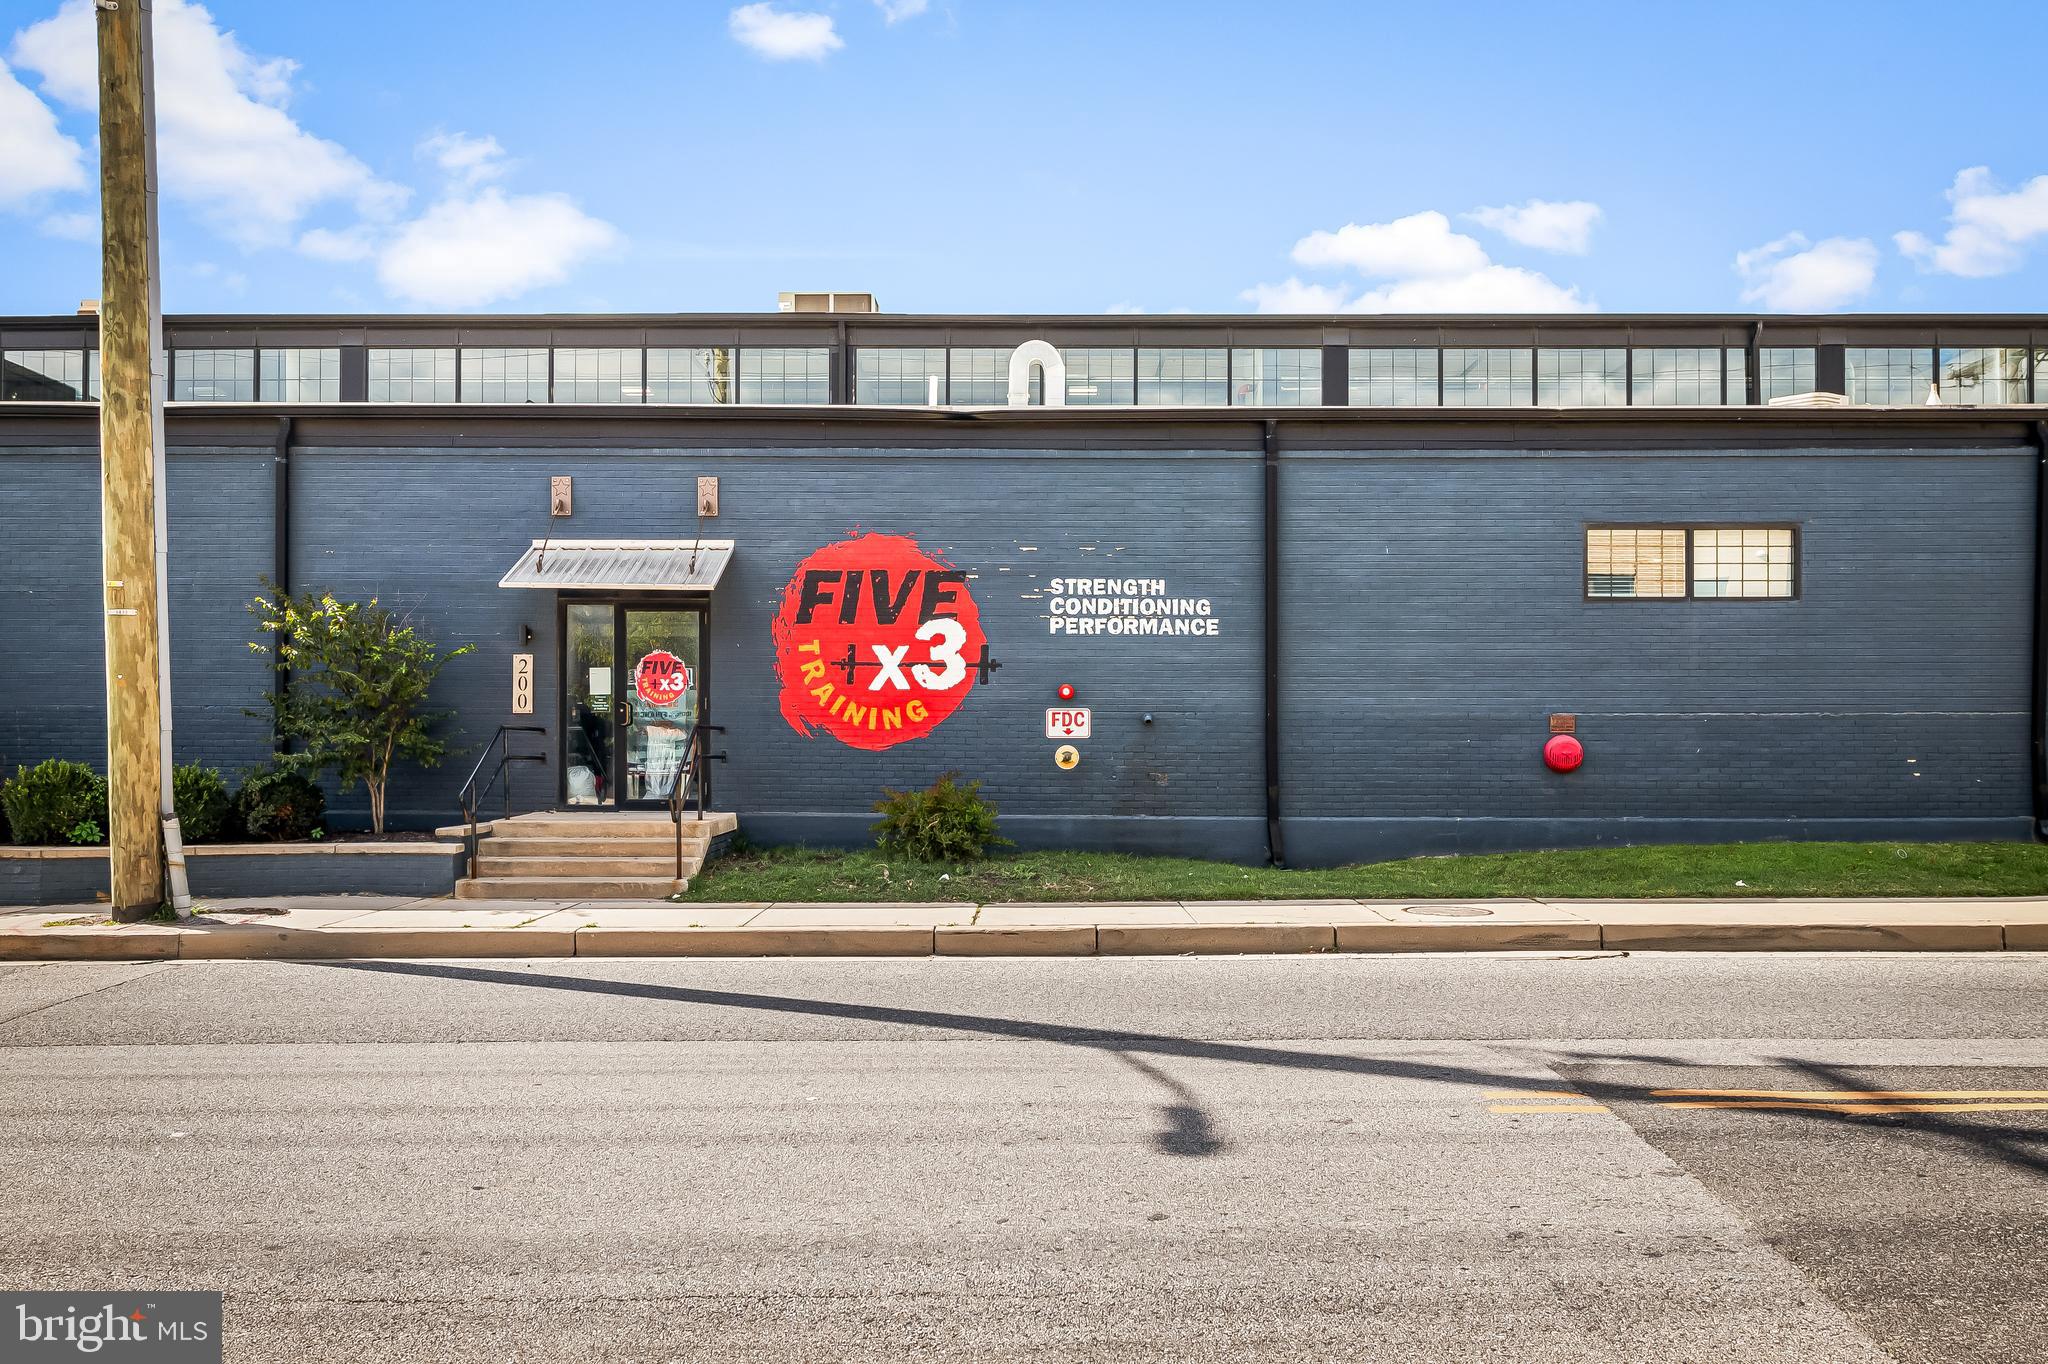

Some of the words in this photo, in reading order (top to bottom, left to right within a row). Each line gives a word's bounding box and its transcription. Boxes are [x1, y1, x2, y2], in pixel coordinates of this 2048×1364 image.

[1050, 578, 1165, 595] STRENGTH
[796, 570, 966, 624] FIVE
[1050, 598, 1211, 615] CONDITIONING
[1050, 618, 1219, 635] PERFORMANCE
[642, 661, 683, 675] FIVE
[517, 658, 529, 709] 200
[642, 677, 675, 700] TRAINING
[798, 639, 929, 730] TRAINING
[1051, 711, 1085, 727] FDC
